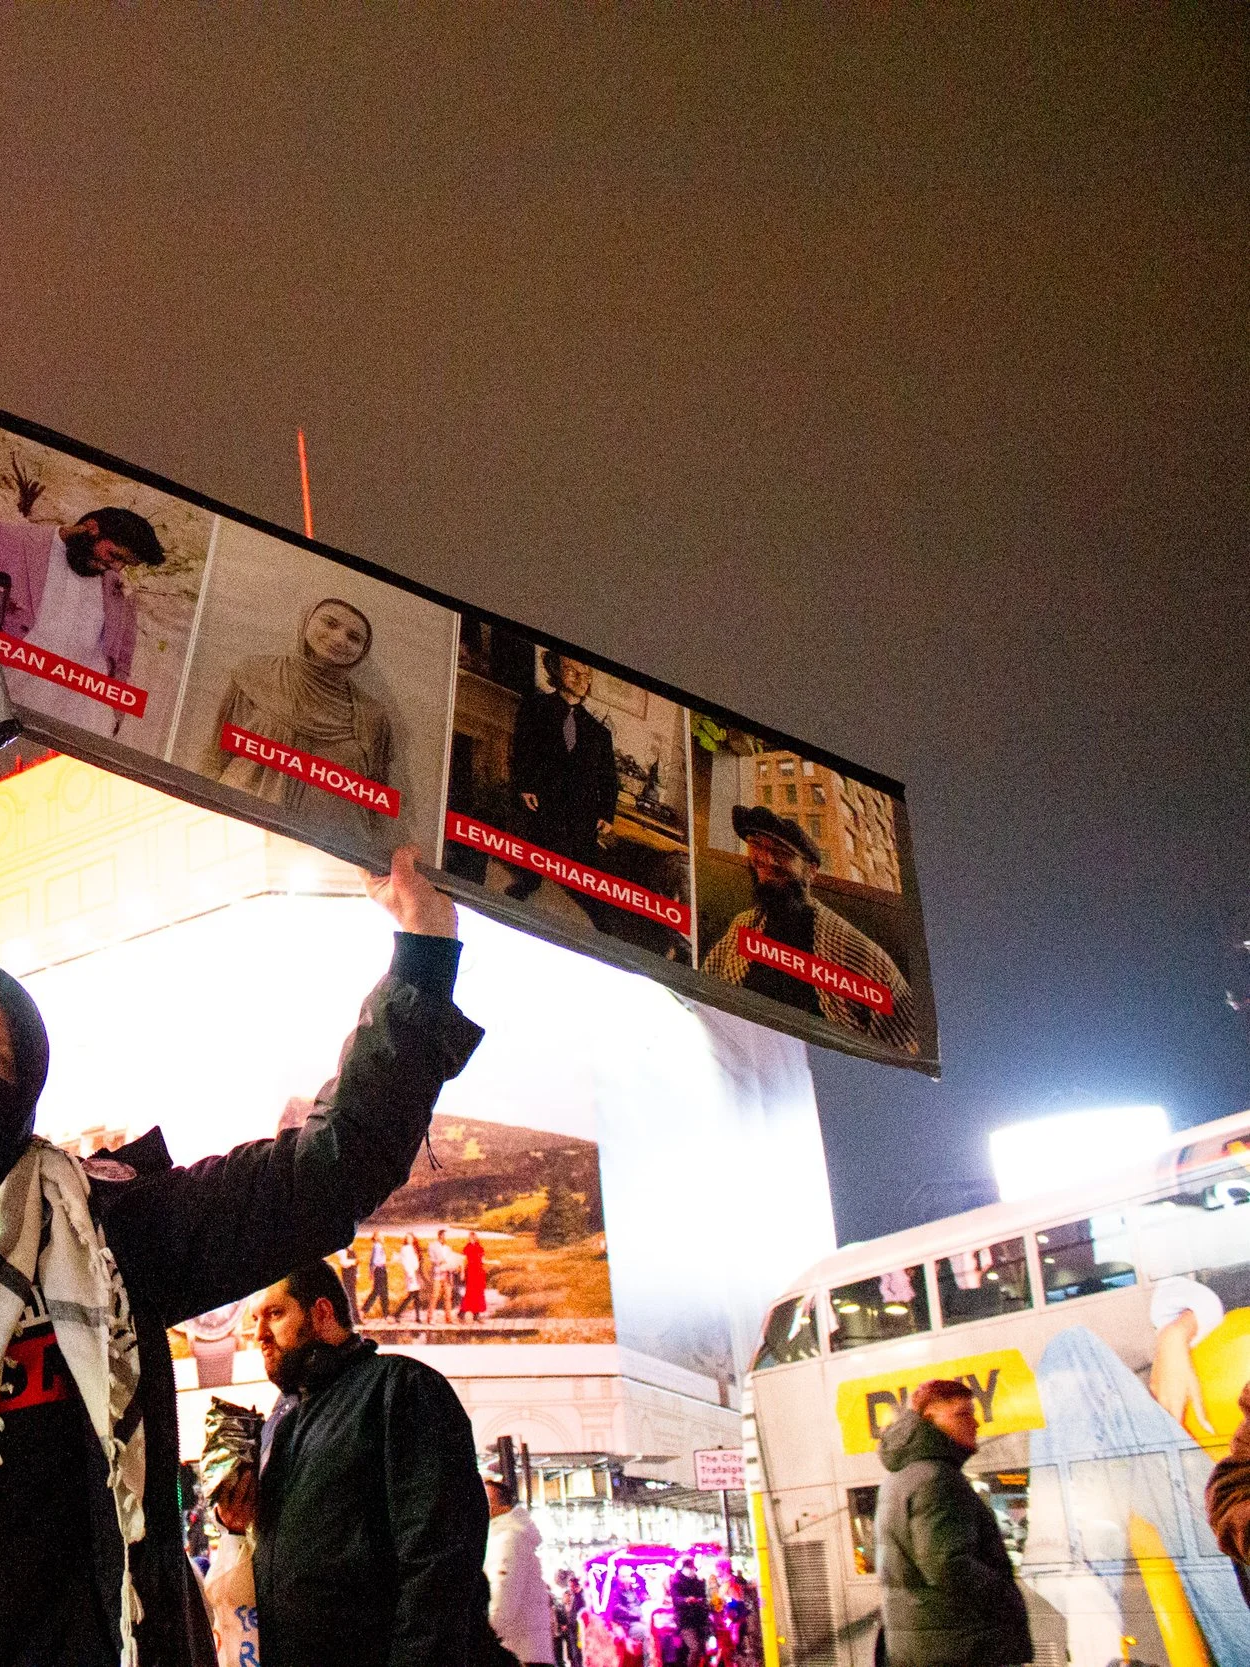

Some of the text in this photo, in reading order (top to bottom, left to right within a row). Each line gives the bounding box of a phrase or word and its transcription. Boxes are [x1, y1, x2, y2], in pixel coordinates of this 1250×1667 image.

[50, 663, 137, 707] AHMED
[231, 732, 391, 809] TEUTA HOXHA
[455, 820, 682, 924] LEWIE CHIARAMELLO
[746, 936, 883, 1004] UMER KHALID
[699, 1453, 742, 1464] The City
[701, 1465, 745, 1475] Trafalga
